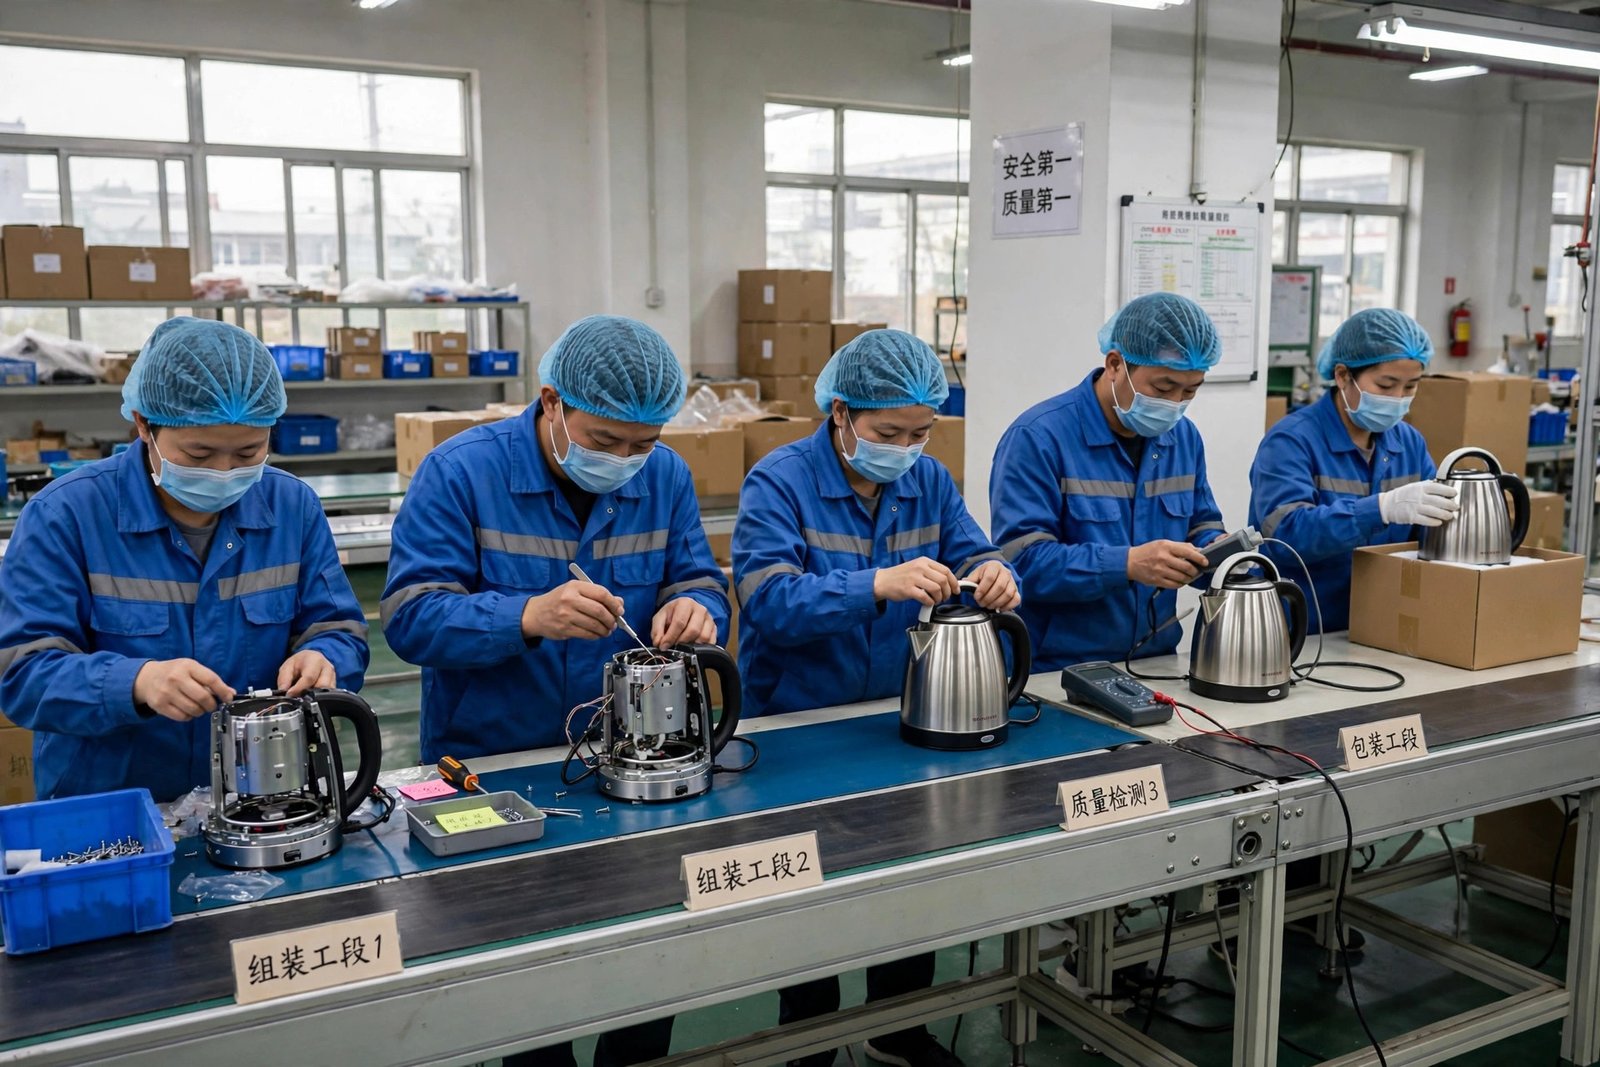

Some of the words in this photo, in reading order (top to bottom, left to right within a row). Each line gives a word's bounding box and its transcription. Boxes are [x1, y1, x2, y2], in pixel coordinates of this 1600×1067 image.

[1003, 150, 1072, 180] 安全第一
[1002, 187, 1071, 216] 质量第一
[1351, 727, 1419, 759] 包装工段
[1072, 780, 1158, 818] 质量检测3
[696, 851, 810, 894] 组装工段2
[248, 934, 381, 985] 组装工段1
